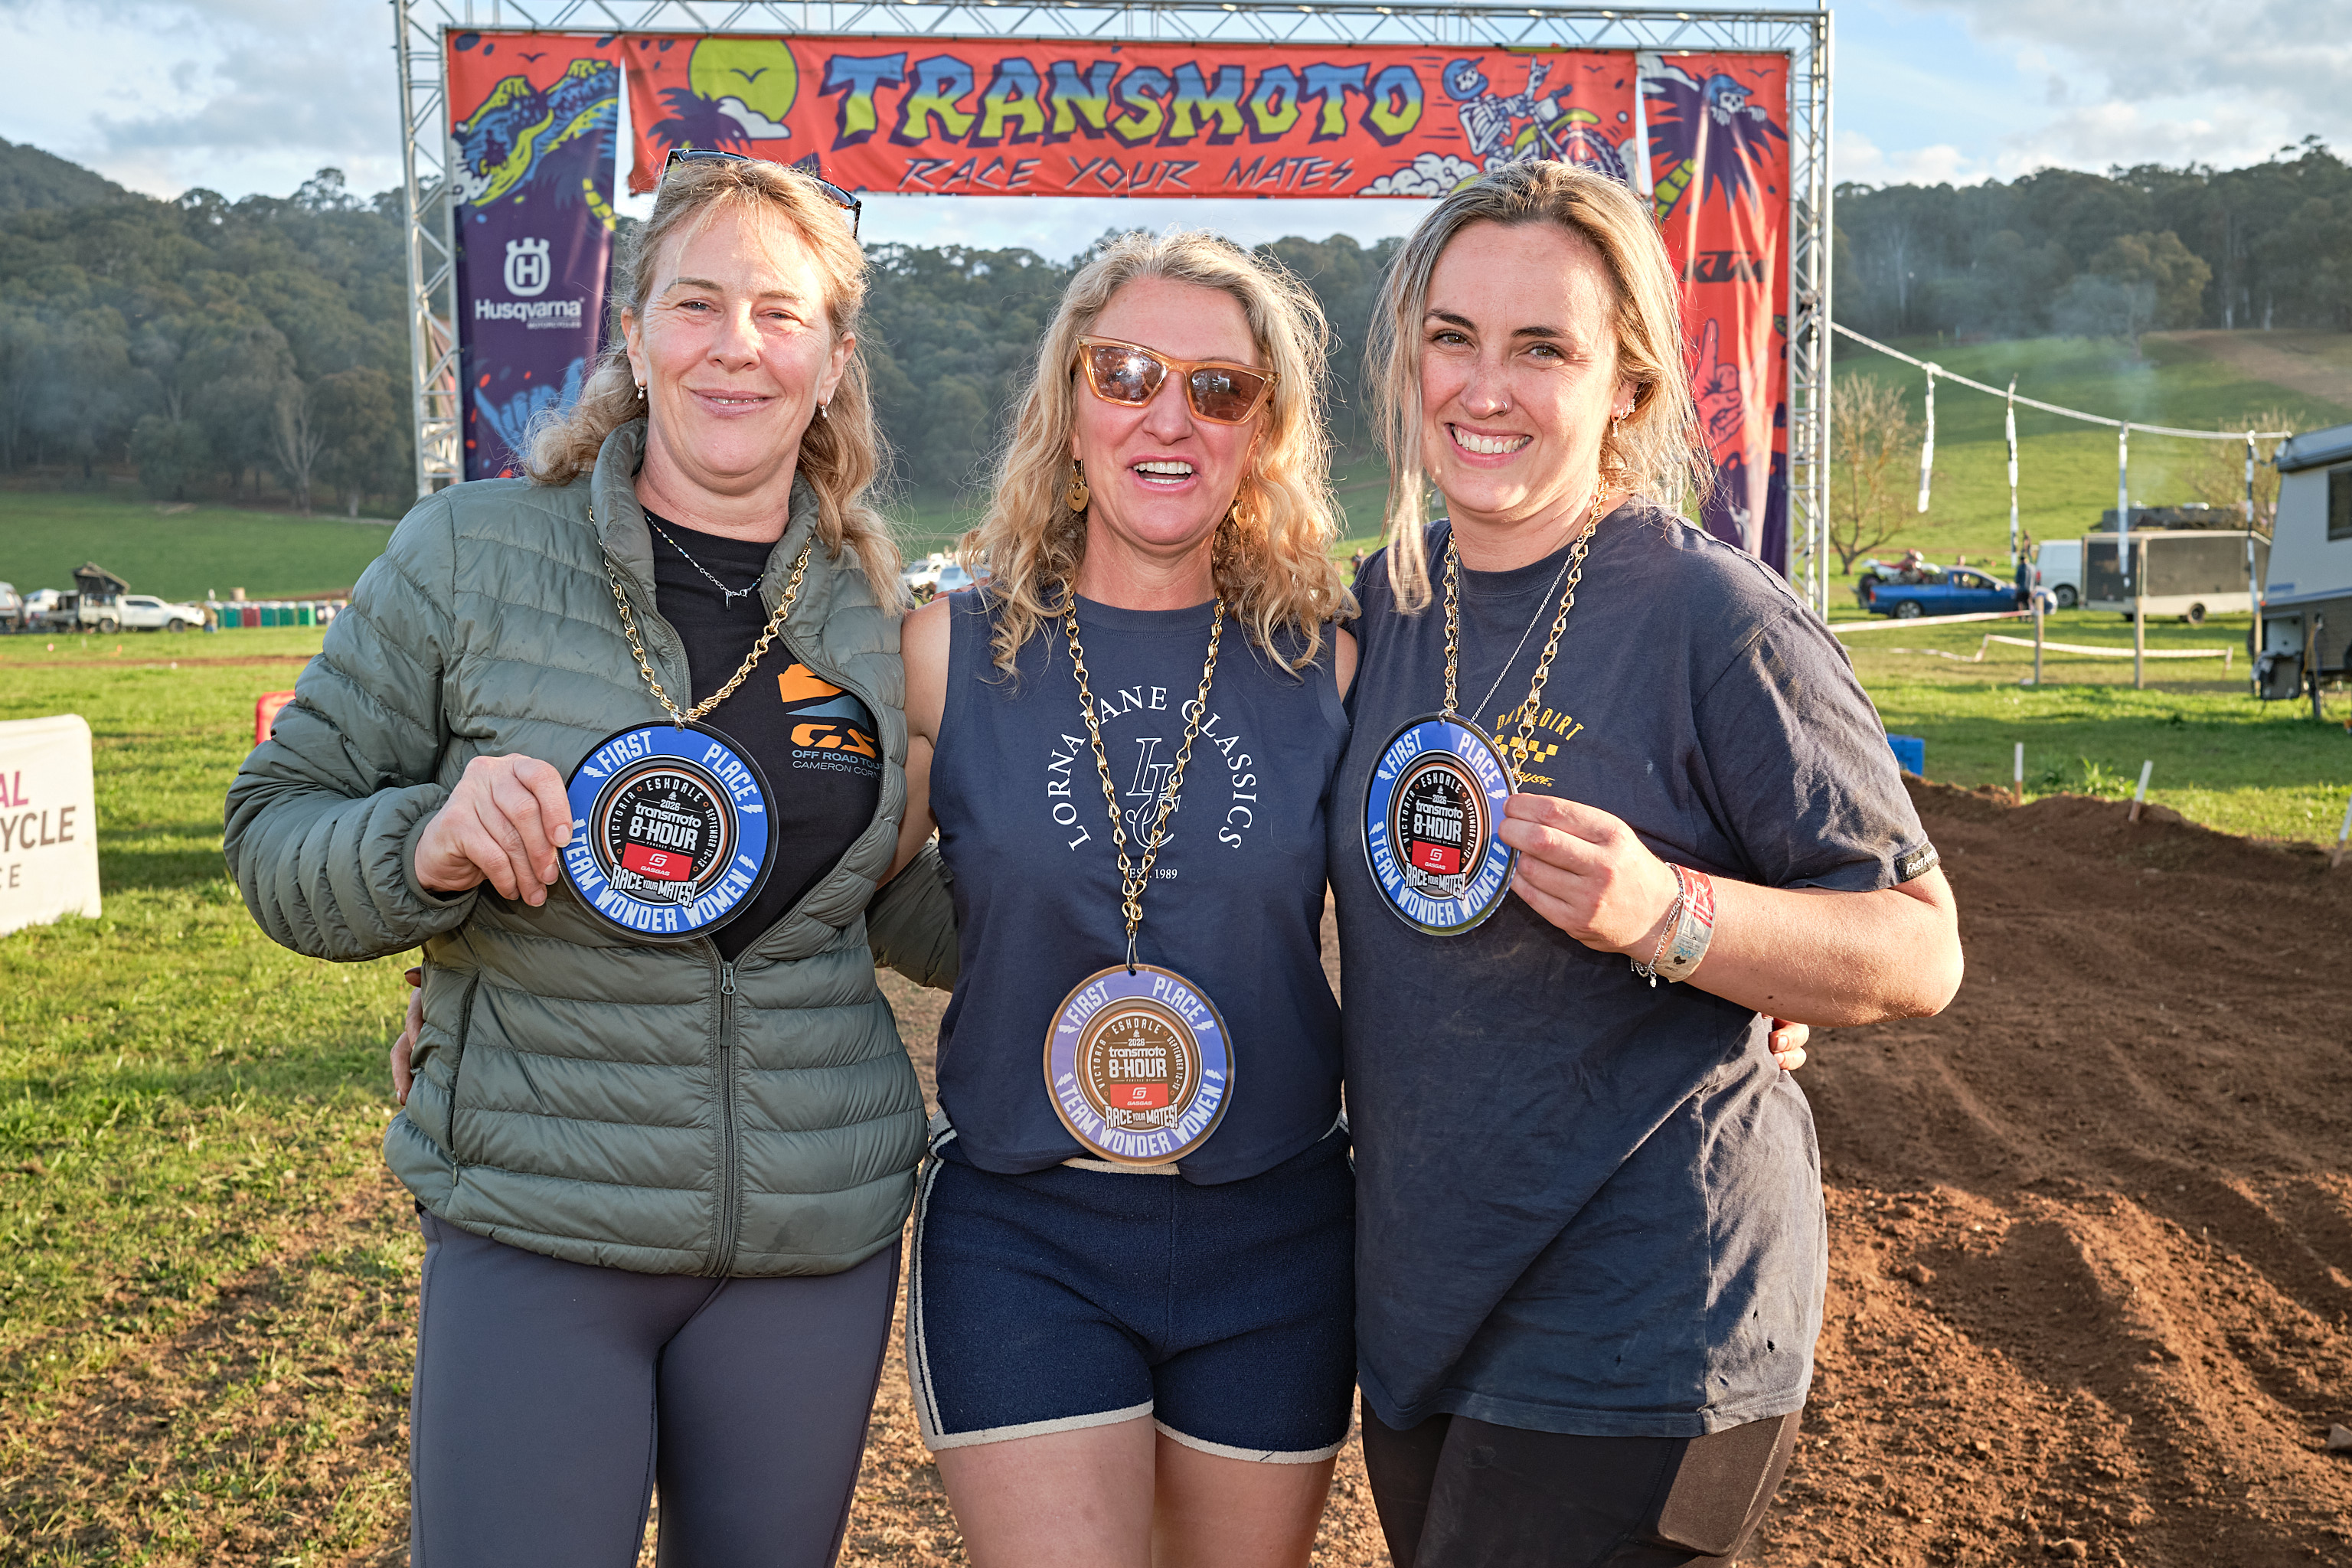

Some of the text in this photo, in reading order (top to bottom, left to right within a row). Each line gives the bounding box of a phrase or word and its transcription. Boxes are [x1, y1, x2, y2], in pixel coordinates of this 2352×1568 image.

[818, 51, 1424, 152] TRANSMOTO
[897, 155, 1354, 191] RACE YOUR MATES
[475, 298, 582, 322] Husqvarna
[1538, 708, 1584, 740] DIRT
[596, 730, 757, 802] FIRST PLACE
[792, 750, 820, 759] OFF
[822, 752, 858, 763] ROAD
[792, 760, 851, 773] CAMERON
[1385, 728, 1501, 788] FIRST PLACE
[645, 777, 704, 802] ESHDALE
[1047, 733, 1092, 851] LORNA
[1181, 698, 1257, 849] CLASSICS
[1420, 773, 1462, 794] ESHDALE
[612, 792, 636, 844] VICTORIA
[635, 802, 702, 828] transmoto
[1401, 789, 1416, 844] VICTORIA
[1416, 799, 1463, 819] transmoto
[1465, 798, 1476, 838] SEPTEMBER
[629, 815, 698, 851] 8-HOUR
[705, 808, 720, 848] SEPTEMBER
[1413, 813, 1462, 842] 8-HOUR
[566, 835, 752, 932] TEAM WONDER WOMEN
[640, 866, 670, 876] GASGAS
[1129, 868, 1178, 879] ES. 1989
[1371, 835, 1505, 925] TEAM WONDER WOMEN
[1406, 861, 1466, 900] RACE YOUR MATES!
[1425, 861, 1446, 871] GASGAS
[610, 865, 697, 907] RACE YOUR MATES!
[1066, 976, 1206, 1026] FIRST PLACE
[1111, 1018, 1161, 1034] ESHDALE
[1093, 1039, 1106, 1089] VICTORIA
[1109, 1046, 1167, 1057] transmoto
[1109, 1058, 1168, 1078] 8-HOUR
[1167, 1036, 1184, 1070] SEPTEMBER
[1060, 1083, 1223, 1157] TEAM WONDER WOMEN
[1105, 1103, 1178, 1129] RACE YOUR MATES!
